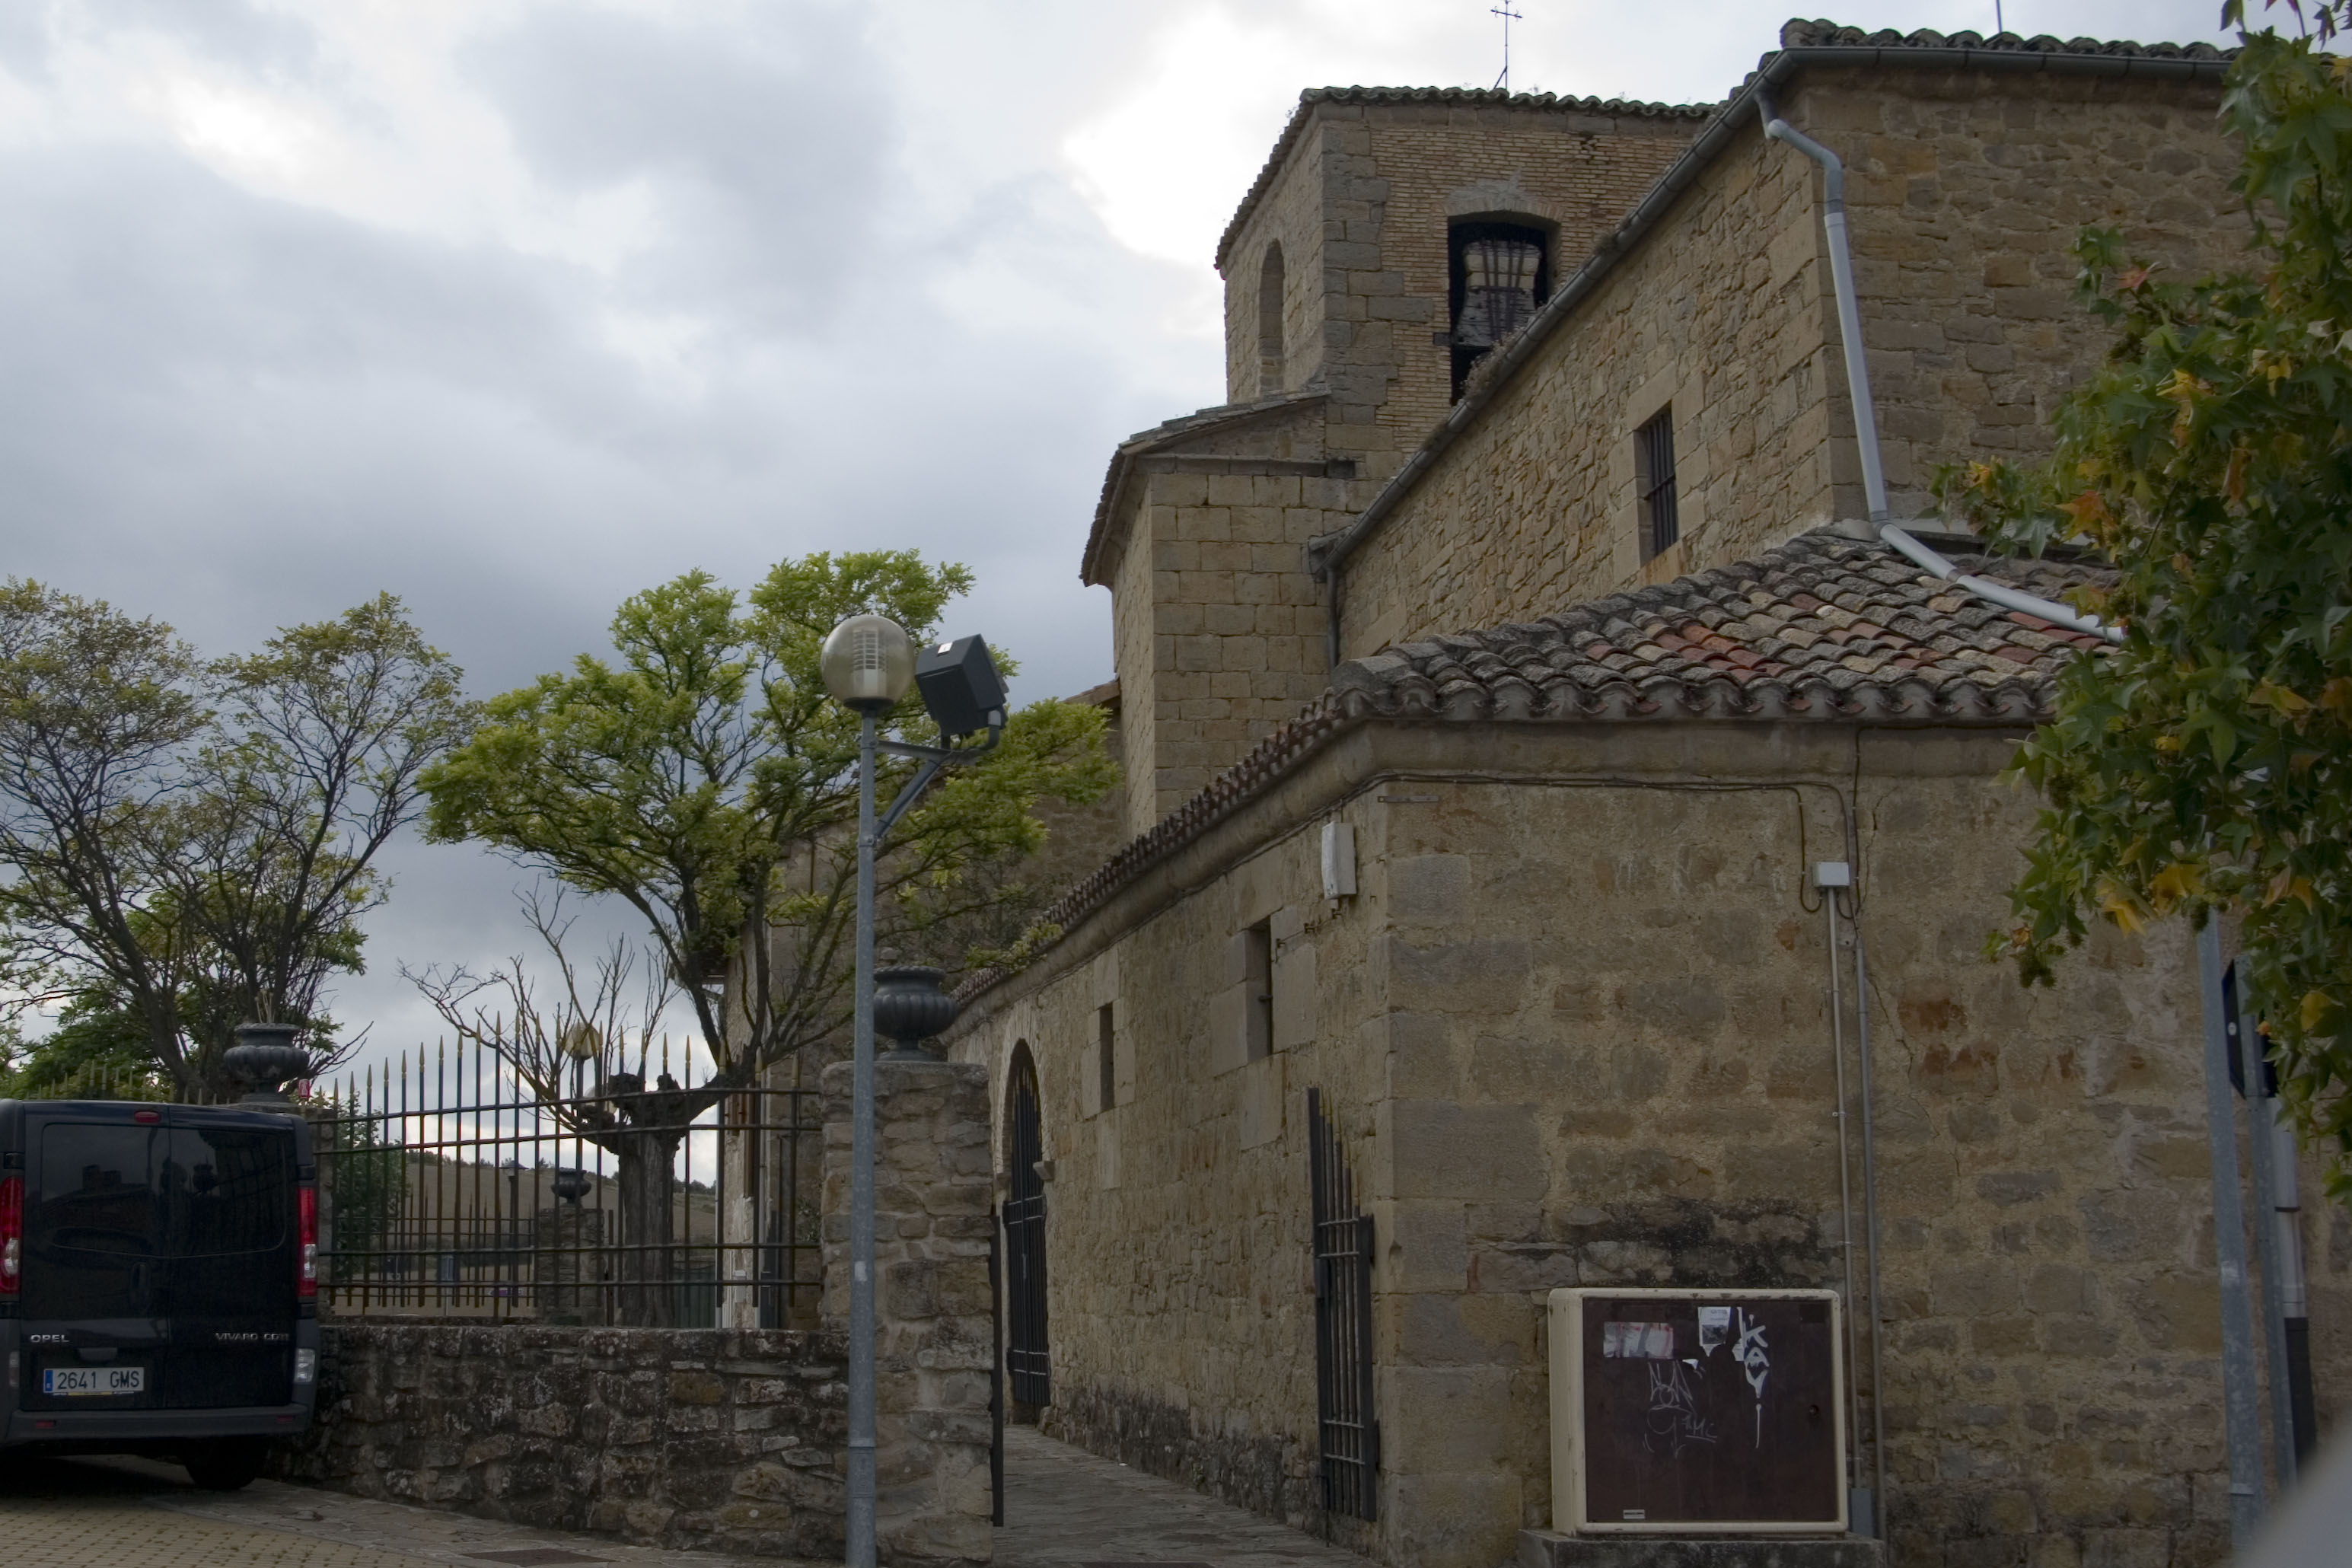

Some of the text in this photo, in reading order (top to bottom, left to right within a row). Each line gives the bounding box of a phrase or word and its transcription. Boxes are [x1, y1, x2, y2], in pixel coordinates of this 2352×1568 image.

[30, 1334, 69, 1343] OPEL
[215, 1332, 259, 1340] VIVARO
[57, 1370, 140, 1389] 2641 GMS
